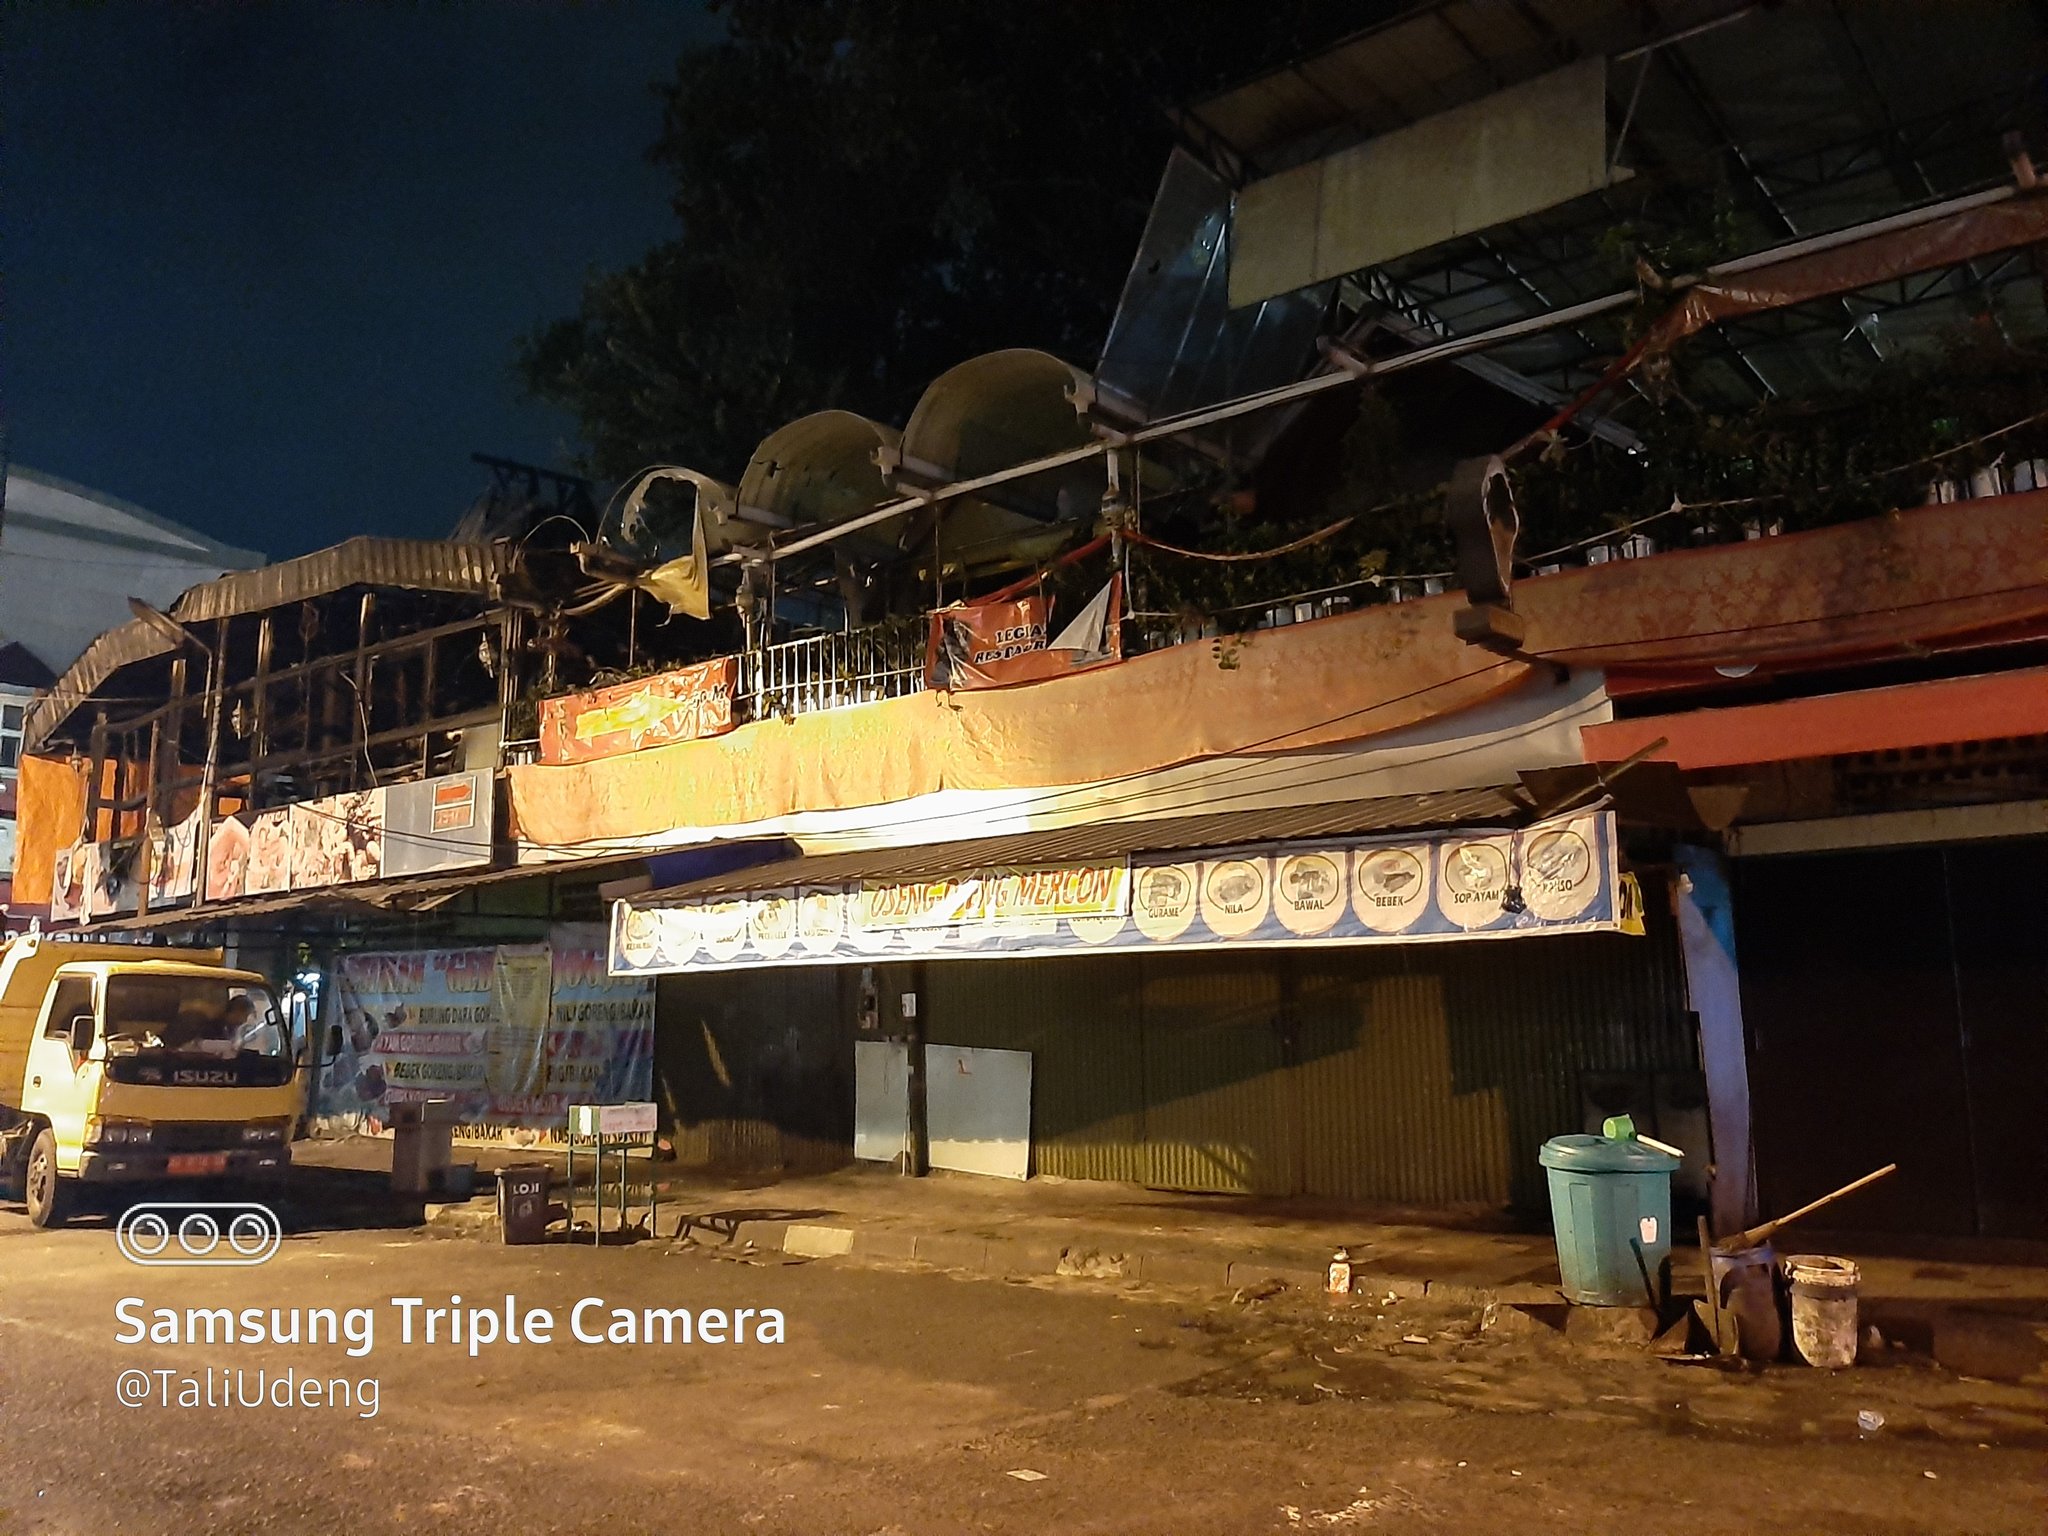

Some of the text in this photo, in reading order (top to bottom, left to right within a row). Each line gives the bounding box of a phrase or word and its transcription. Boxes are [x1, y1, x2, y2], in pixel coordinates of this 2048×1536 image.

[1014, 866, 1115, 907] MERCON
[1375, 895, 1404, 907] BEBEK
[1454, 890, 1500, 903] SOP AYAM
[1224, 905, 1244, 914] NILA
[1293, 899, 1325, 911] BAWAL
[1148, 907, 1180, 918] GURAME
[174, 1070, 238, 1084] ISUZU
